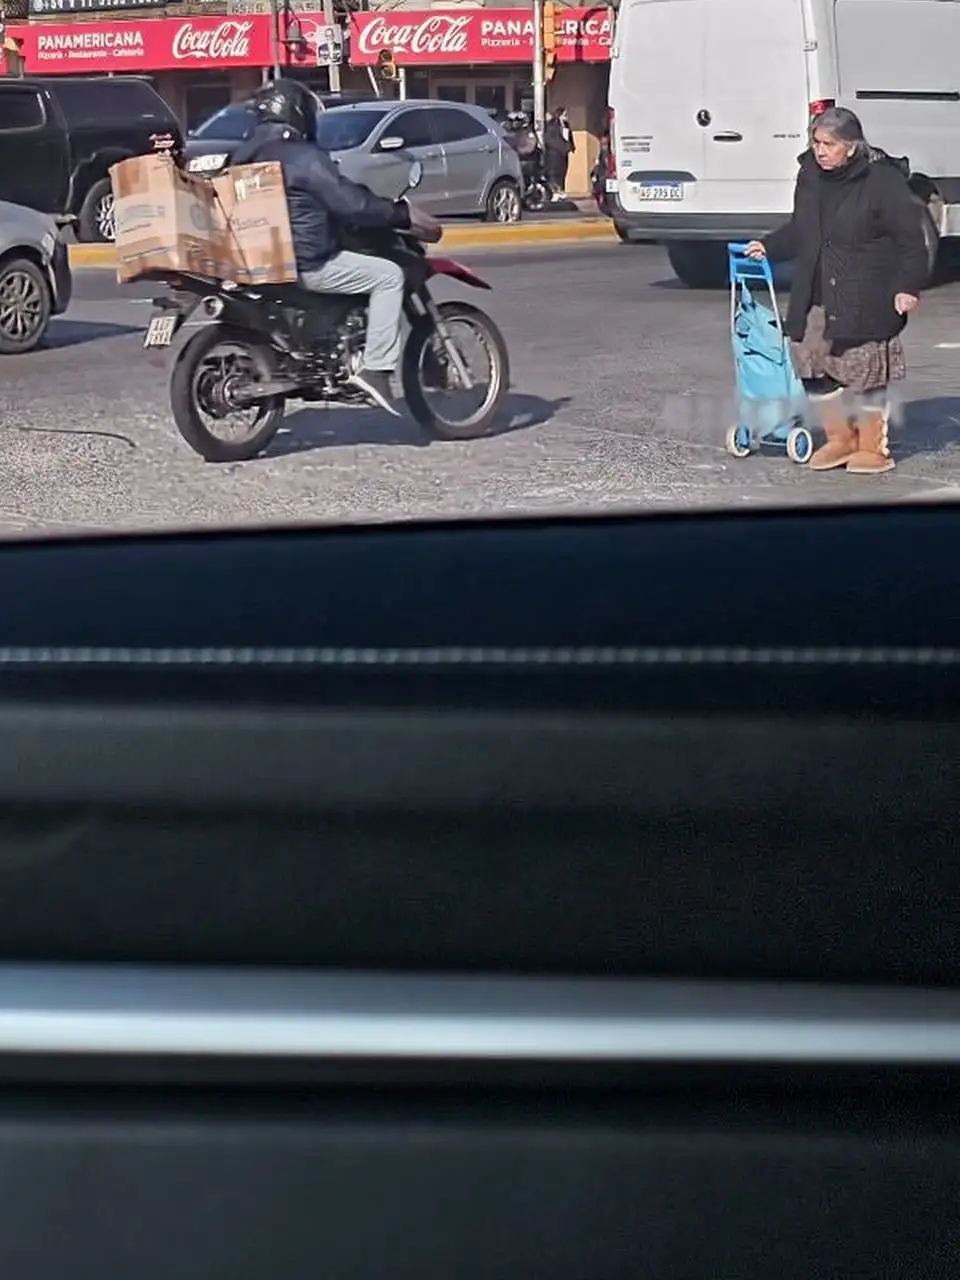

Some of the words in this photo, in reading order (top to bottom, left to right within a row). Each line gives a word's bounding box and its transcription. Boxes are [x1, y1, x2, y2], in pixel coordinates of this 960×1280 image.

[37, 31, 144, 50] PANAMERICANA
[171, 21, 254, 59] Coca-Cola
[358, 15, 474, 54] Coca-Cola
